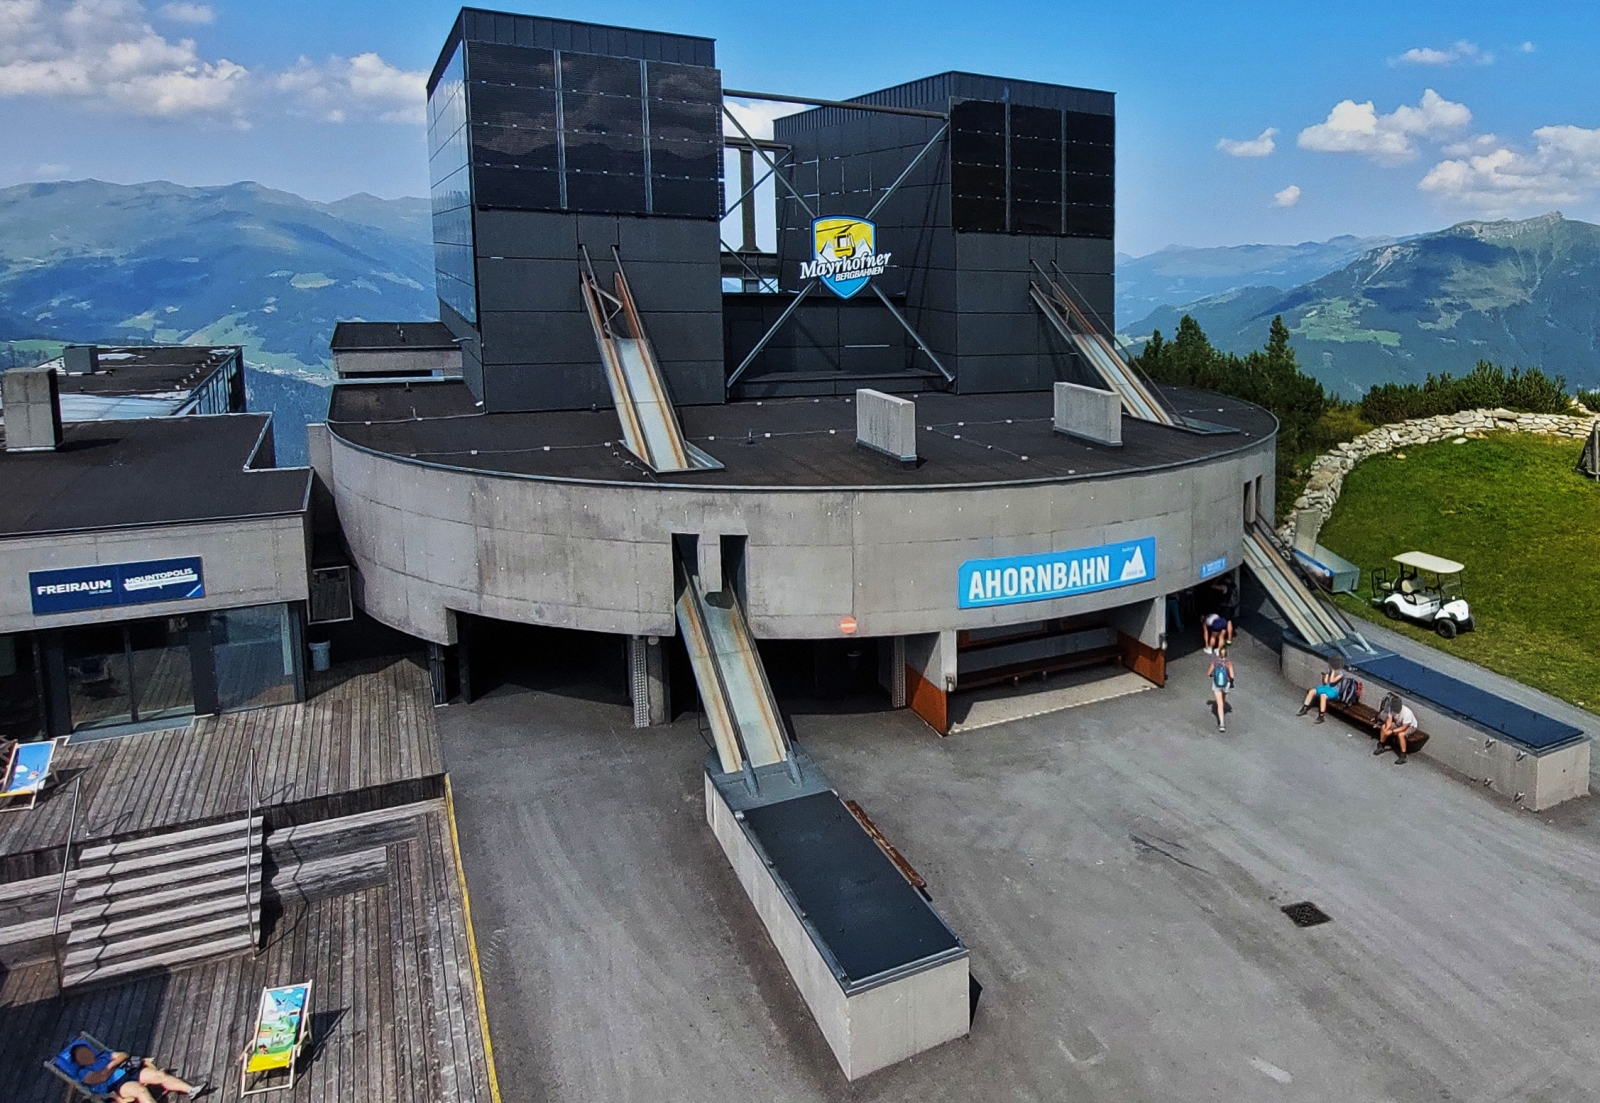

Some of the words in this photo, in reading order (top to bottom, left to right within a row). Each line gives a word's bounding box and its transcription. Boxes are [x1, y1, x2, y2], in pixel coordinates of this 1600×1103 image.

[800, 252, 891, 279] Mayrhofner
[835, 266, 884, 281] BERGBAHNEN
[125, 568, 194, 584] MOUNTOPOLIS
[968, 555, 1110, 600] AHORNBAHN
[37, 580, 112, 595] FREIRAUM
